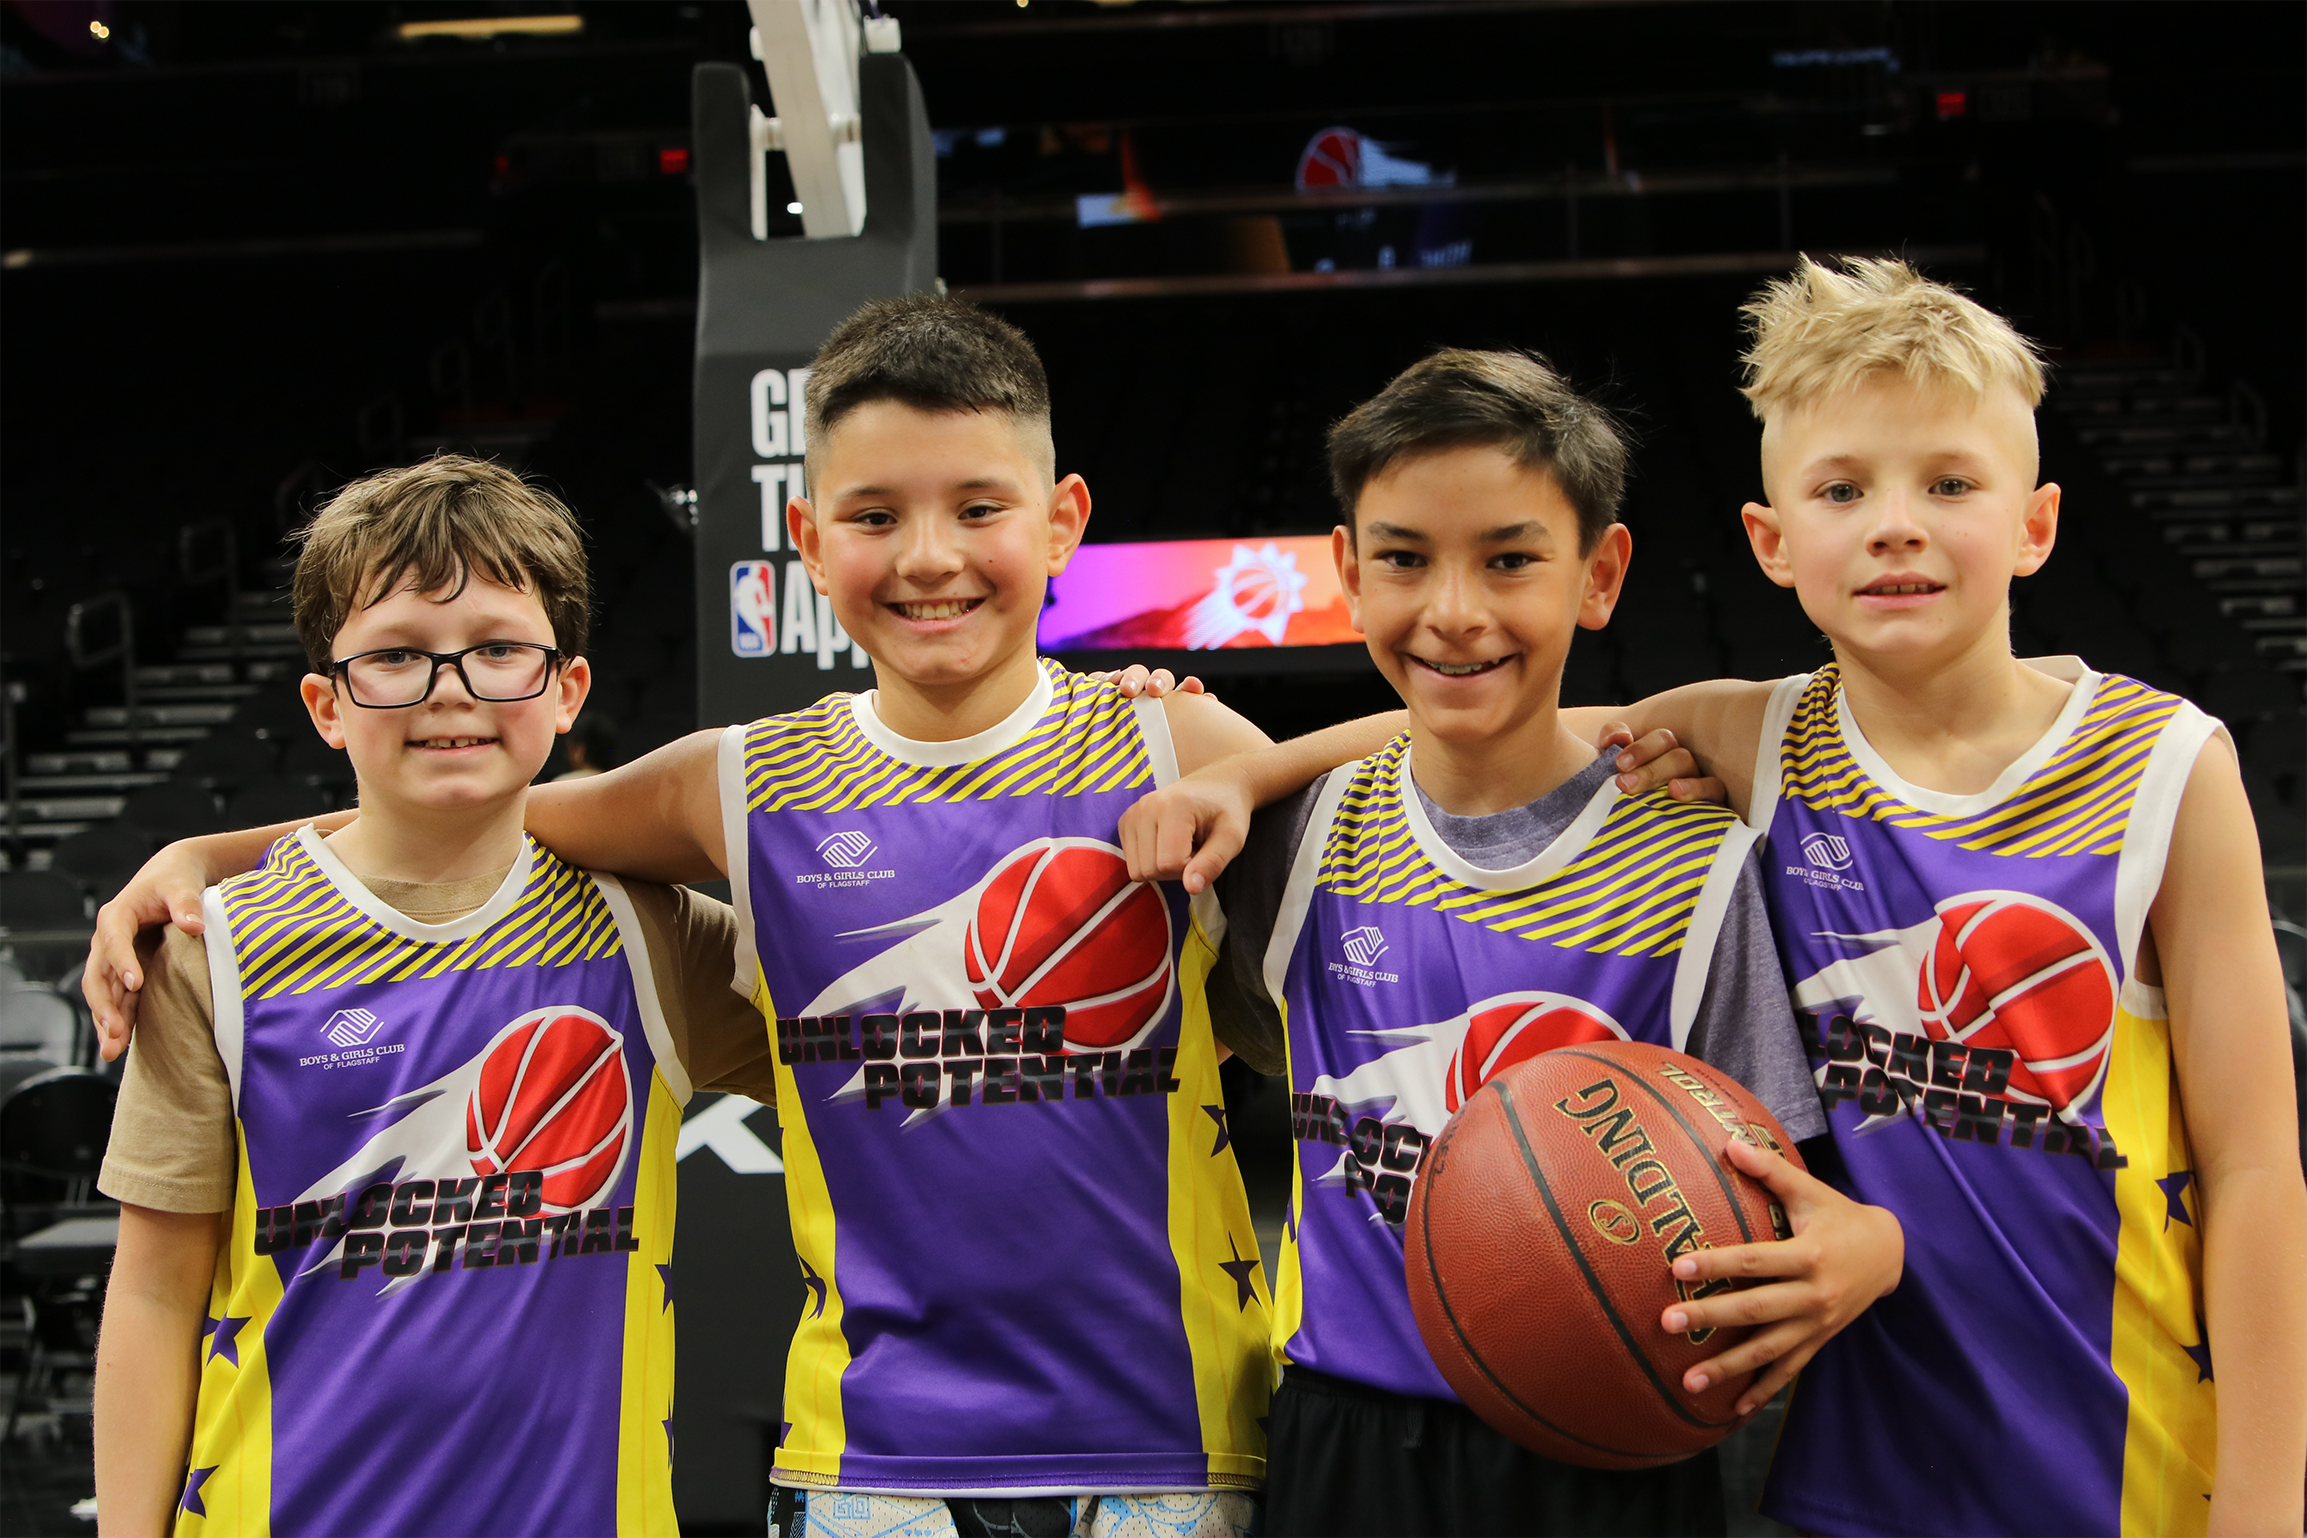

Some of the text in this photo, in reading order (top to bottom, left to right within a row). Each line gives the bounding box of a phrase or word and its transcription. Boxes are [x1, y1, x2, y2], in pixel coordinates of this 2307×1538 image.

[751, 369, 806, 458] GE
[781, 561, 870, 670] Ap
[796, 870, 895, 883] BOYS & GIRLS CLUB
[829, 880, 870, 888] FLAGSTAFF
[1811, 870, 1840, 883] GIRLS
[1328, 962, 1343, 973] BYS
[1375, 971, 1399, 983] CLUB
[299, 1043, 405, 1067] BOYS & GIRLS CLUB
[337, 1056, 380, 1068] FLAGSTAFF
[776, 1005, 1066, 1065] UNLOCKED
[863, 1046, 1180, 1110] POTENTIAL
[1659, 1062, 1757, 1145] NTROL
[1292, 1091, 1433, 1174] UNLOC
[254, 1169, 544, 1256] UNLOCKED
[339, 1205, 639, 1281] POTENTIAL
